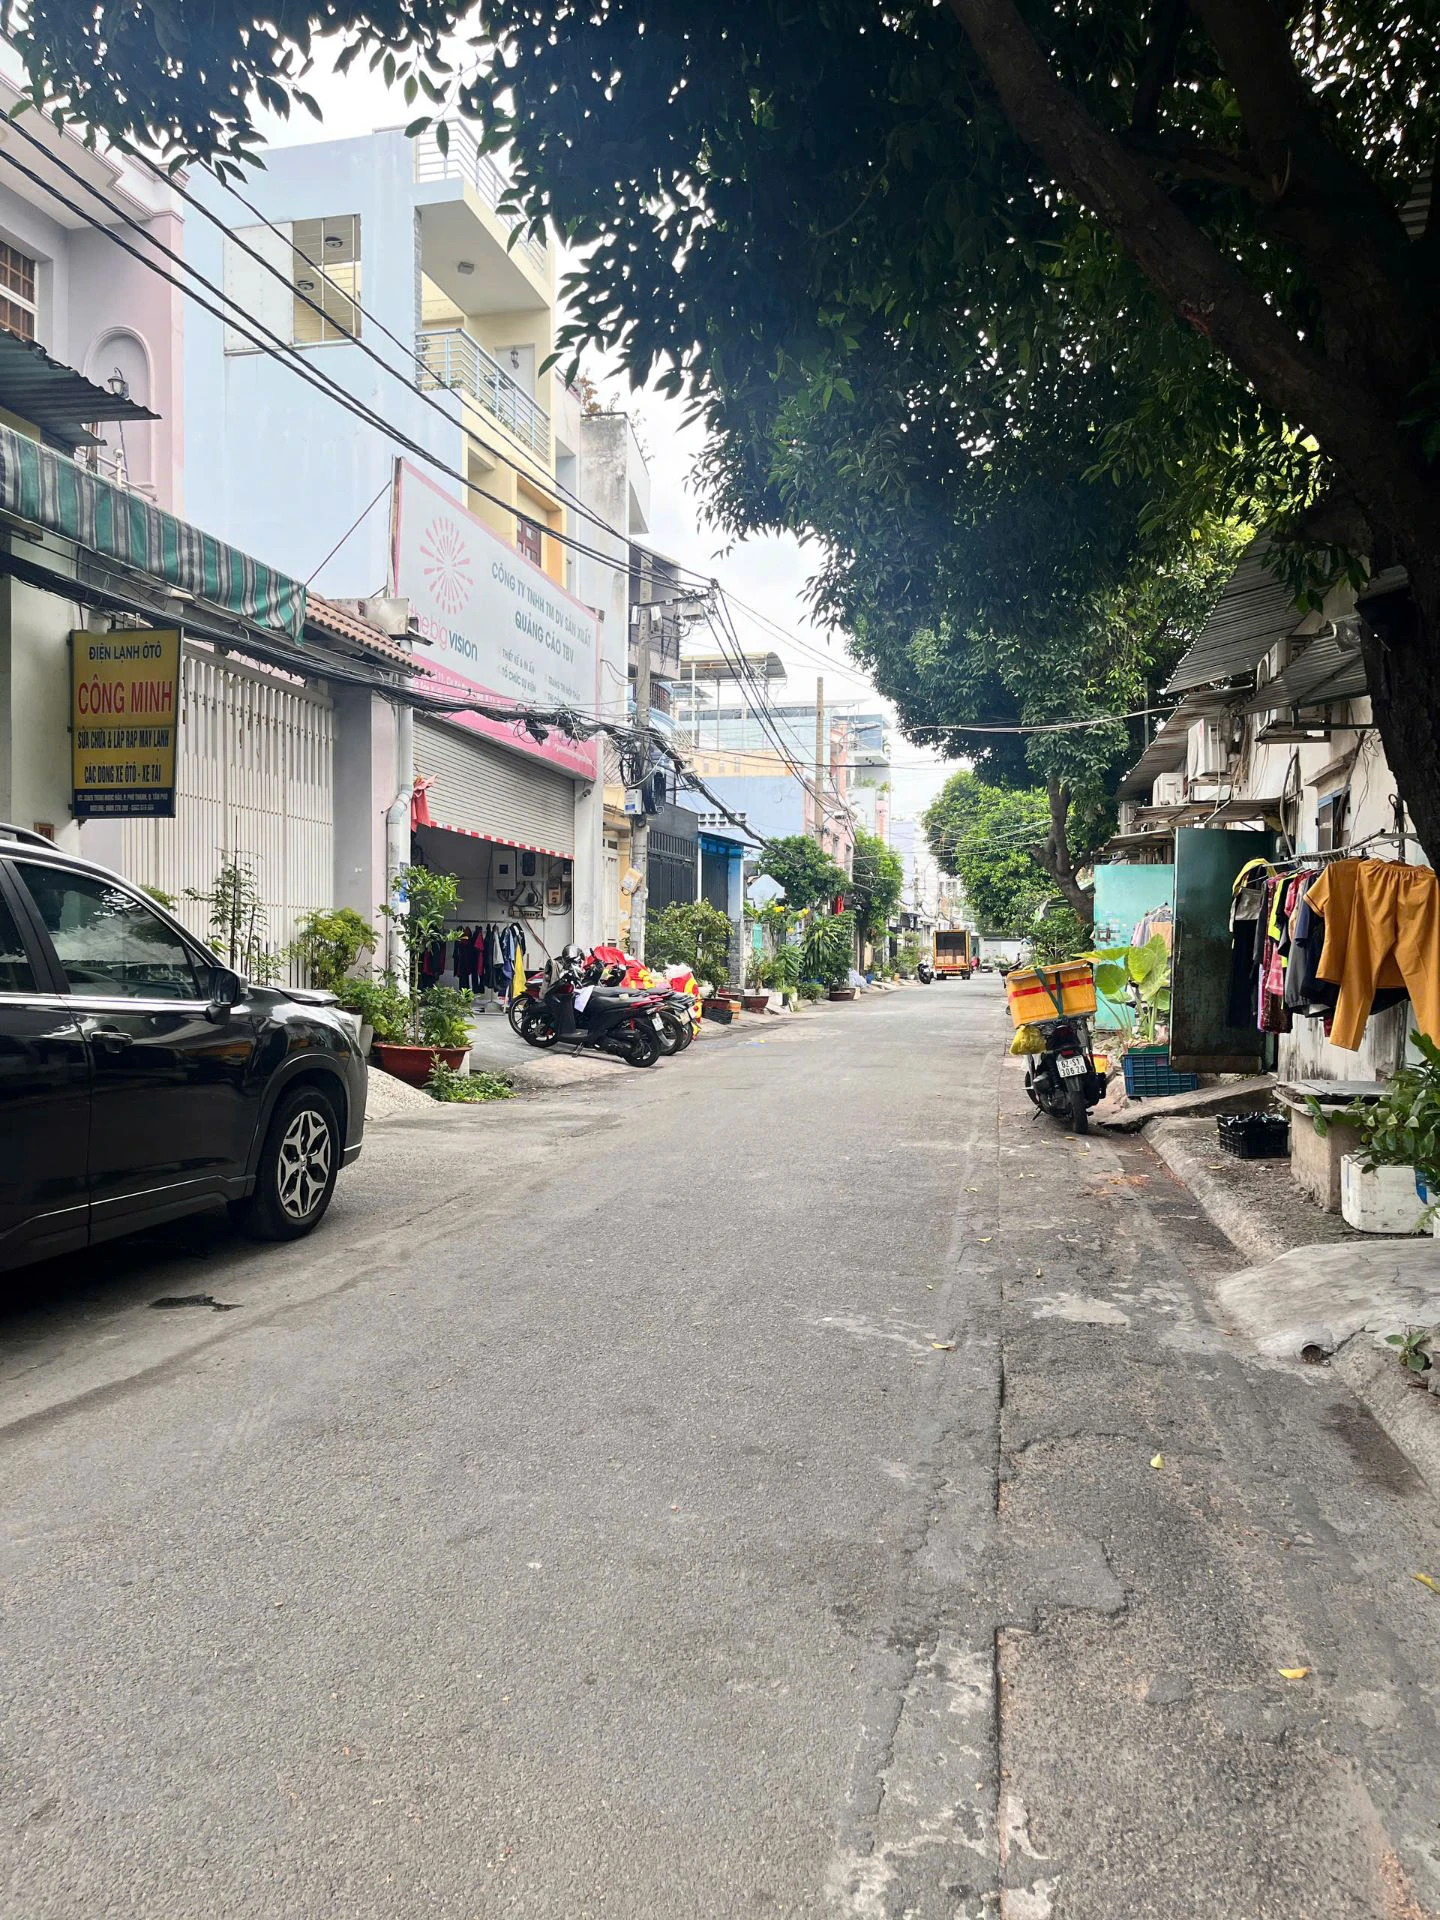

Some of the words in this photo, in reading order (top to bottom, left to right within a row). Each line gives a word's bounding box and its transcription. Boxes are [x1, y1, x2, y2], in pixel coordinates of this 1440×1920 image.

[492, 562, 515, 591] CÔNG
[518, 579, 525, 598] TY
[527, 586, 545, 613] TNHH
[555, 609, 564, 628] DV
[89, 642, 111, 663] ĐIỆN
[113, 645, 139, 663] LẠNH
[142, 640, 162, 658] ÔTÔ
[515, 611, 543, 643] QUẢNG
[545, 631, 561, 655] CÁO
[563, 642, 574, 665] TBV
[78, 673, 125, 715] CÔNG
[130, 680, 173, 713] MINH
[116, 765, 123, 783] XE
[142, 764, 150, 782] XE
